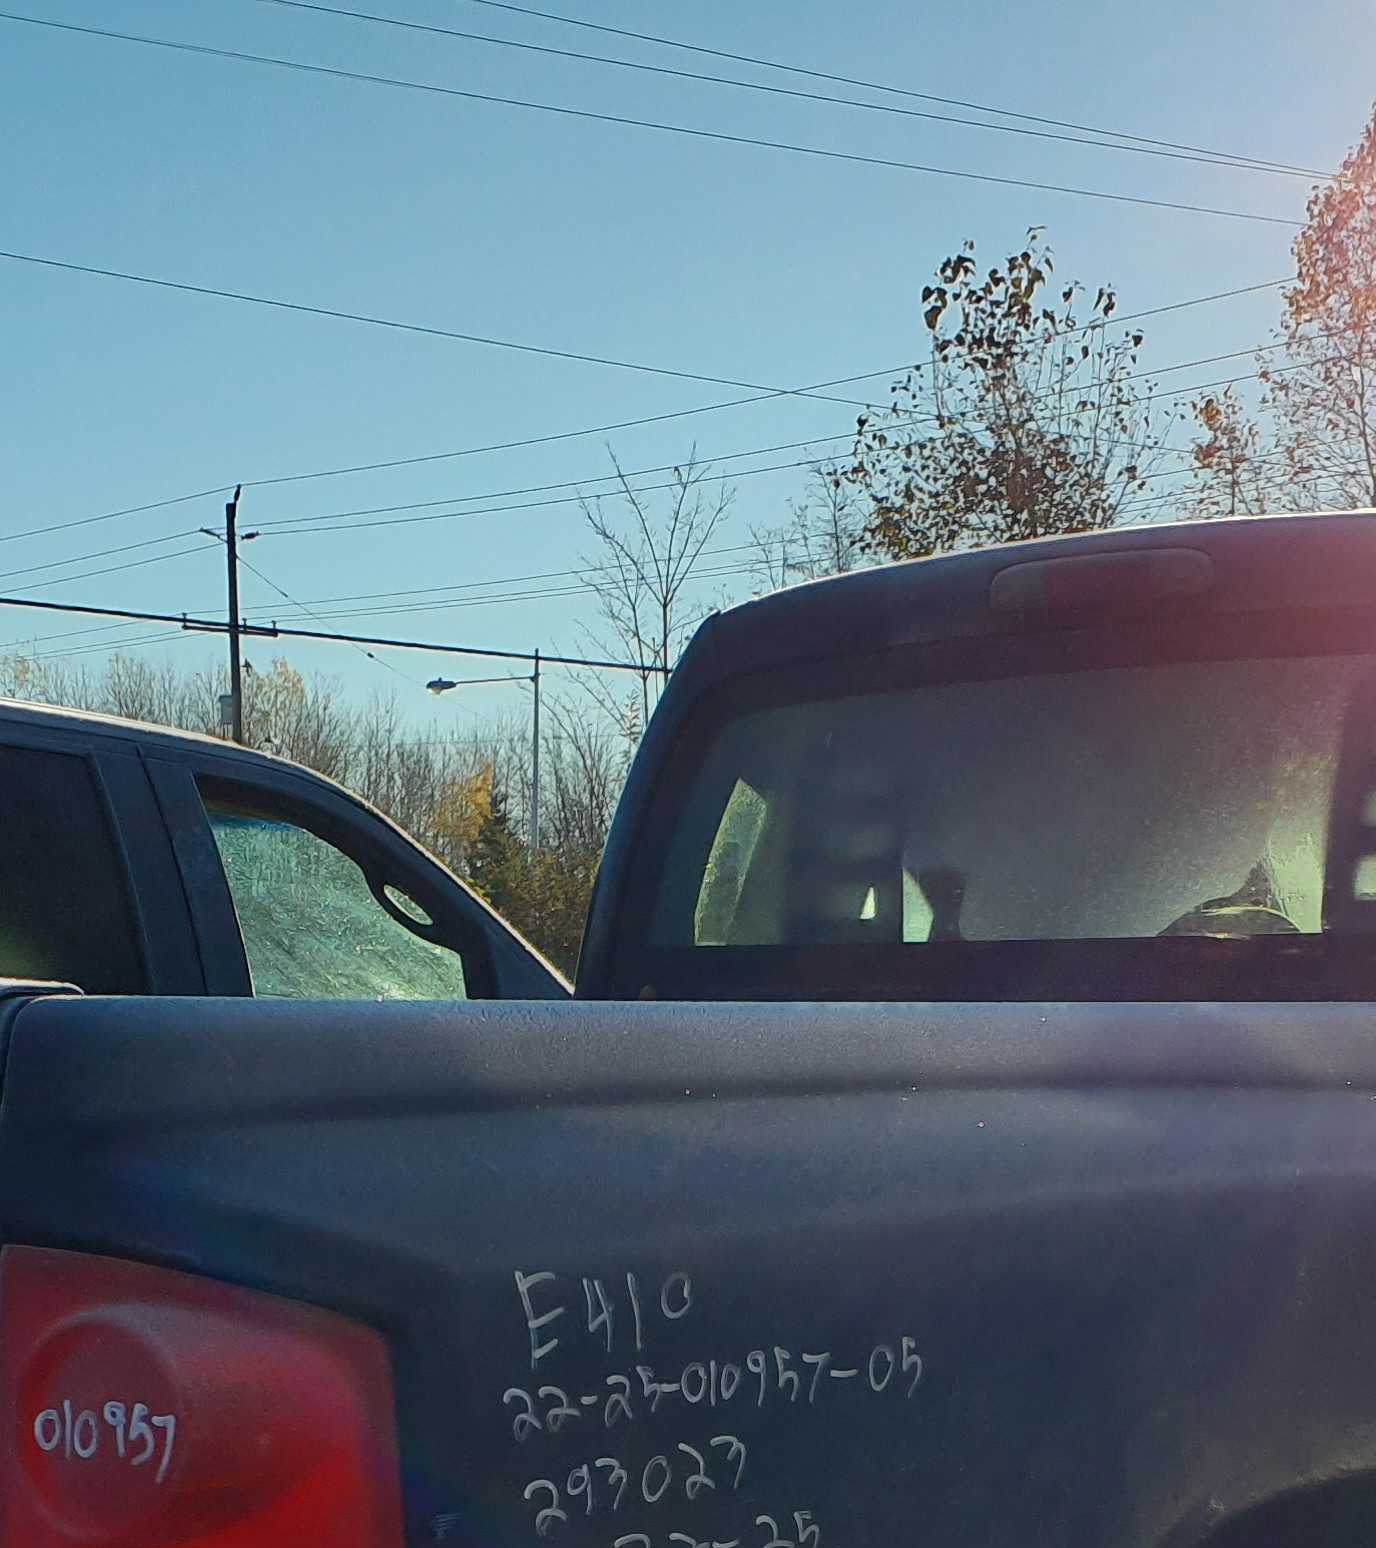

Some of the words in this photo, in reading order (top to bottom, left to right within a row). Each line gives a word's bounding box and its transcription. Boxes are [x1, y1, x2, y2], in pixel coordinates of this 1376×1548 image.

[515, 1270, 691, 1368] E410
[503, 1336, 922, 1440] 22-25-010957-05
[34, 1399, 176, 1484] 010957
[524, 1435, 746, 1535] 293023
